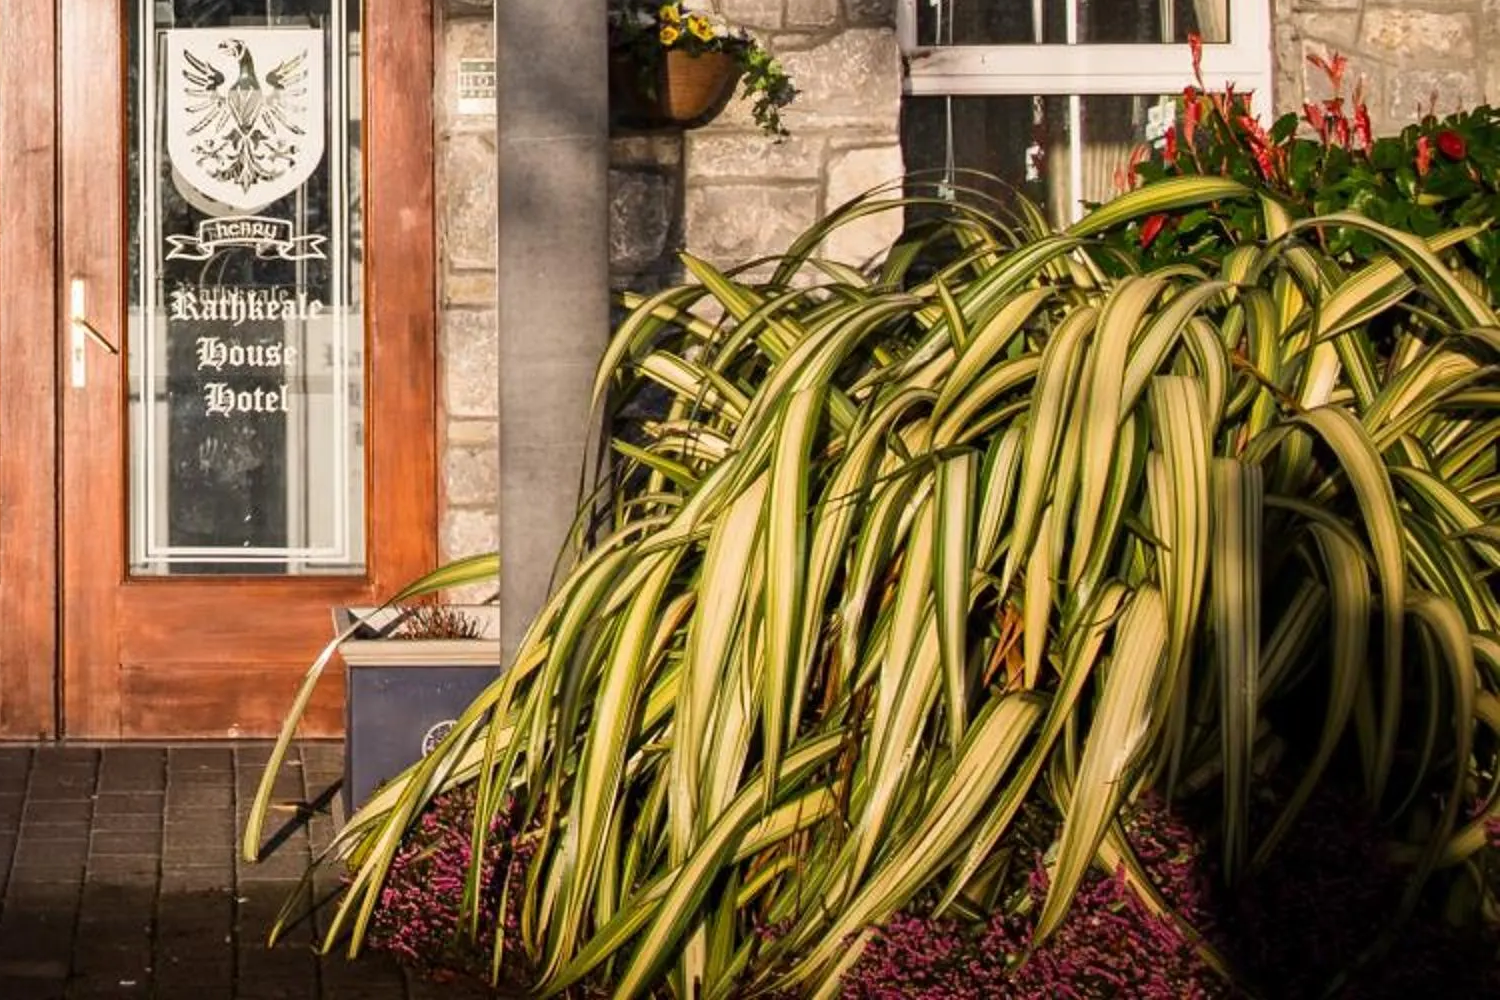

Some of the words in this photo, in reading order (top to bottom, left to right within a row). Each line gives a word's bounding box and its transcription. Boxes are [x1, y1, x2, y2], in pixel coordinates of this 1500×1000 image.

[170, 289, 324, 326] Rathkeale
[196, 336, 298, 371] House
[203, 381, 289, 418] Hotel
